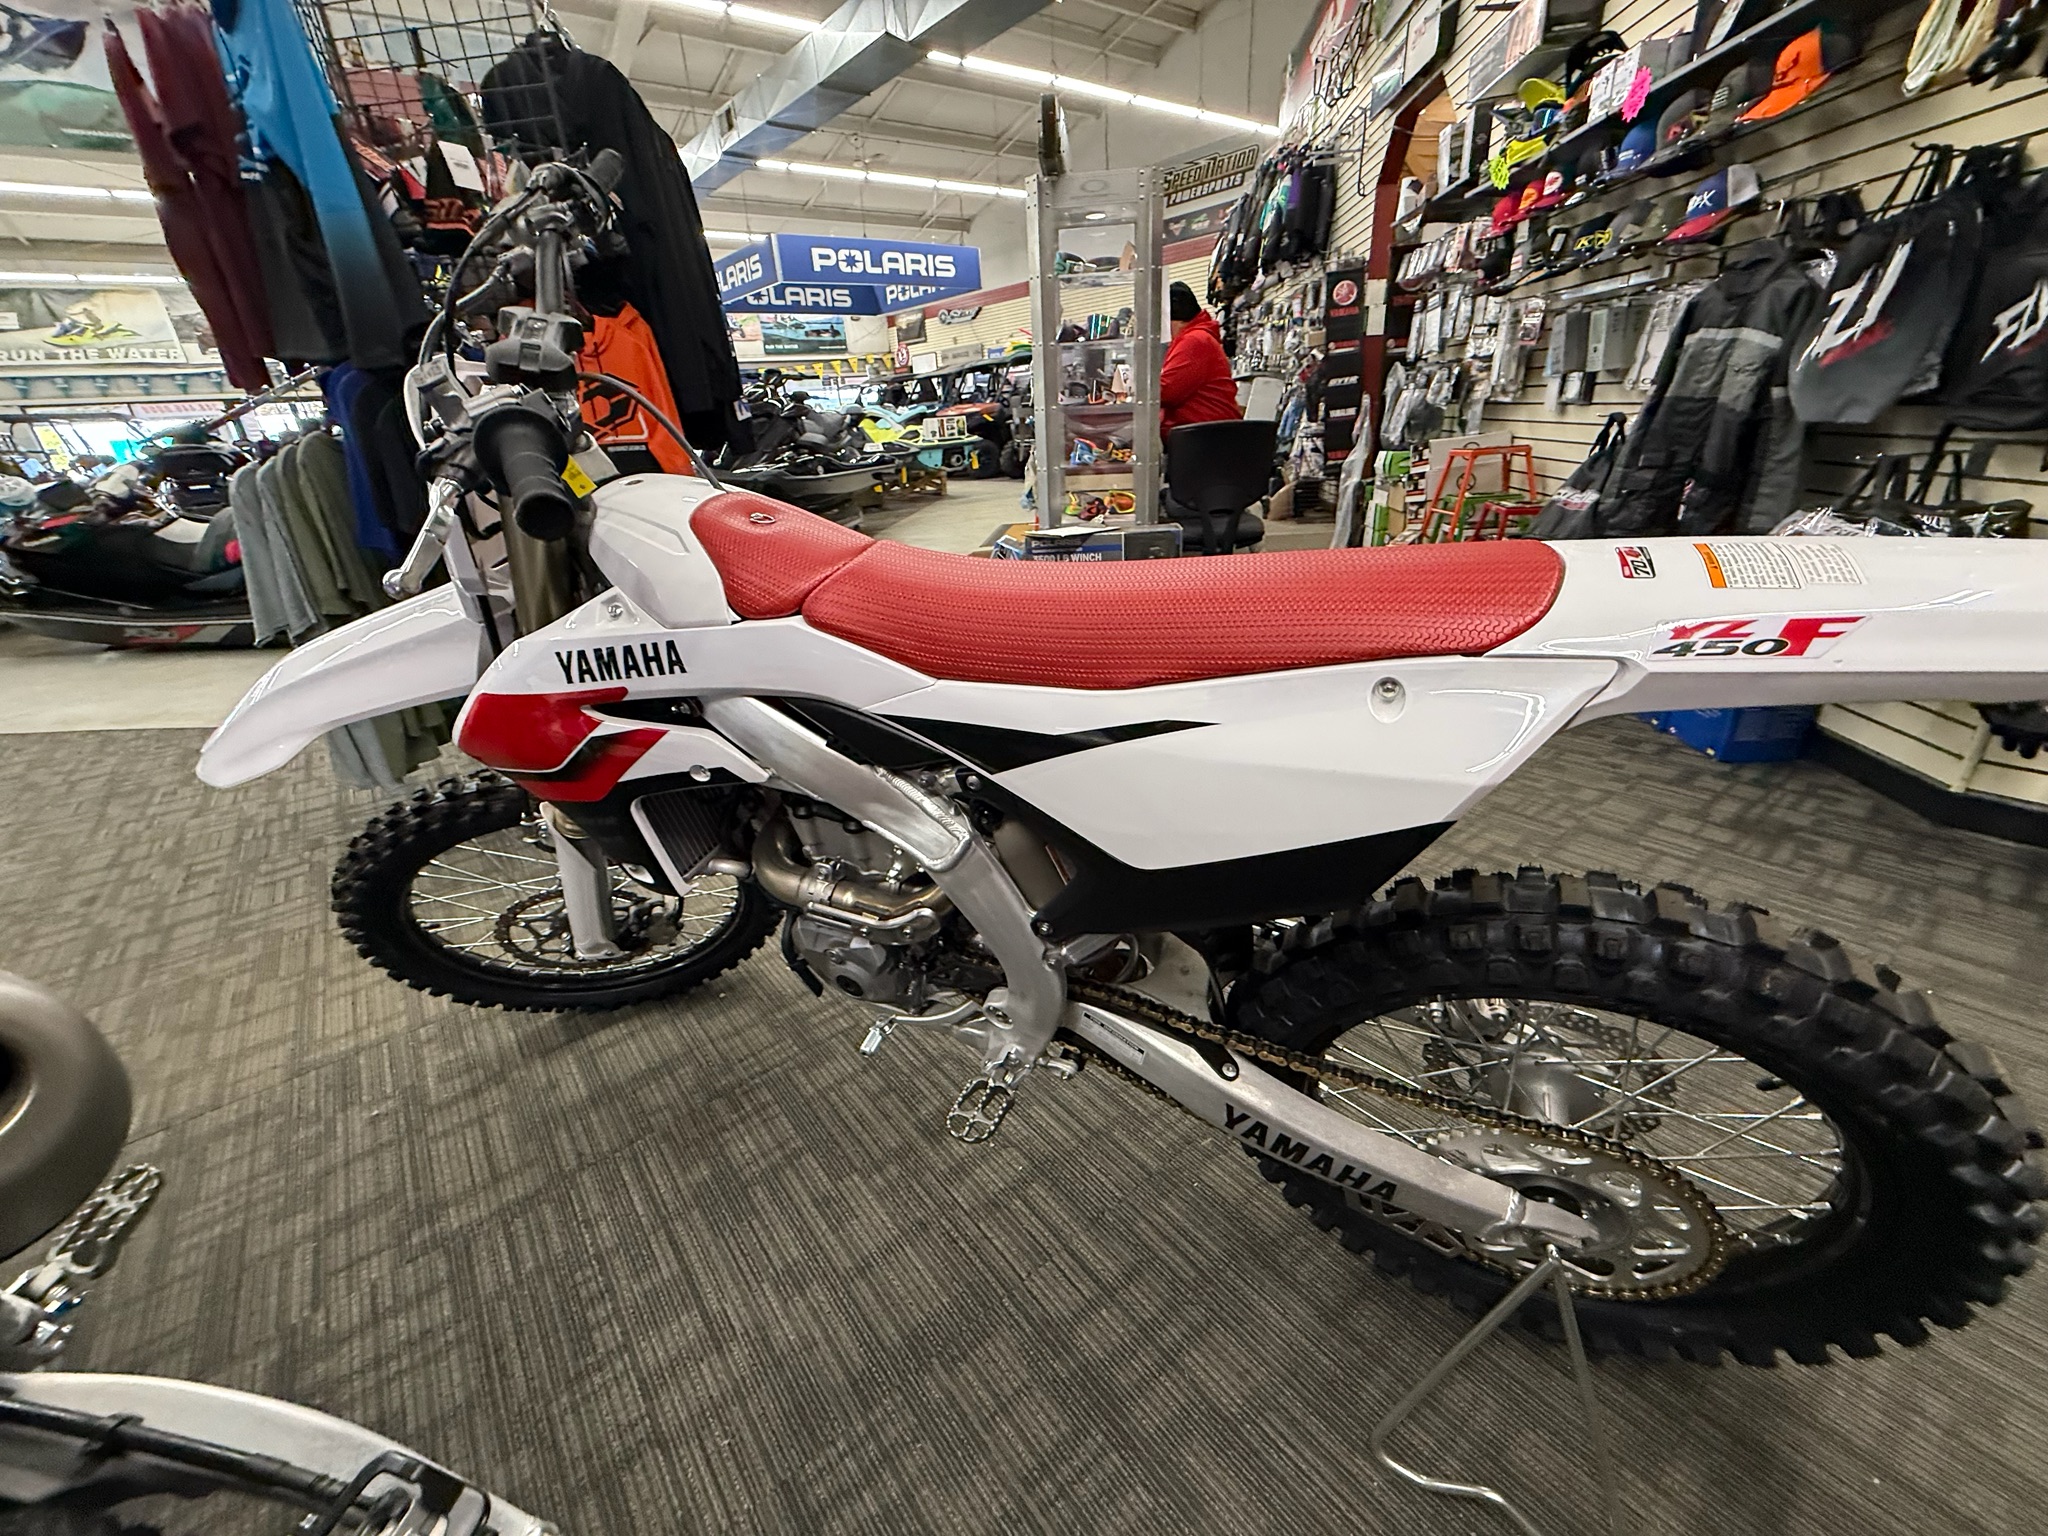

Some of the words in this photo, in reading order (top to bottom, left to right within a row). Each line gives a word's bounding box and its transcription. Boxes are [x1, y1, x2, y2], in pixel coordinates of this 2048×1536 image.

[811, 247, 956, 278] POLARIS
[59, 348, 100, 360] THE
[106, 347, 182, 360] WATER
[1070, 552, 1102, 562] WINCH
[1669, 618, 1759, 640] YZ
[1652, 638, 1790, 658] 450
[554, 639, 688, 684] YAMAHA
[1224, 1102, 1398, 1201] YAMAHA
